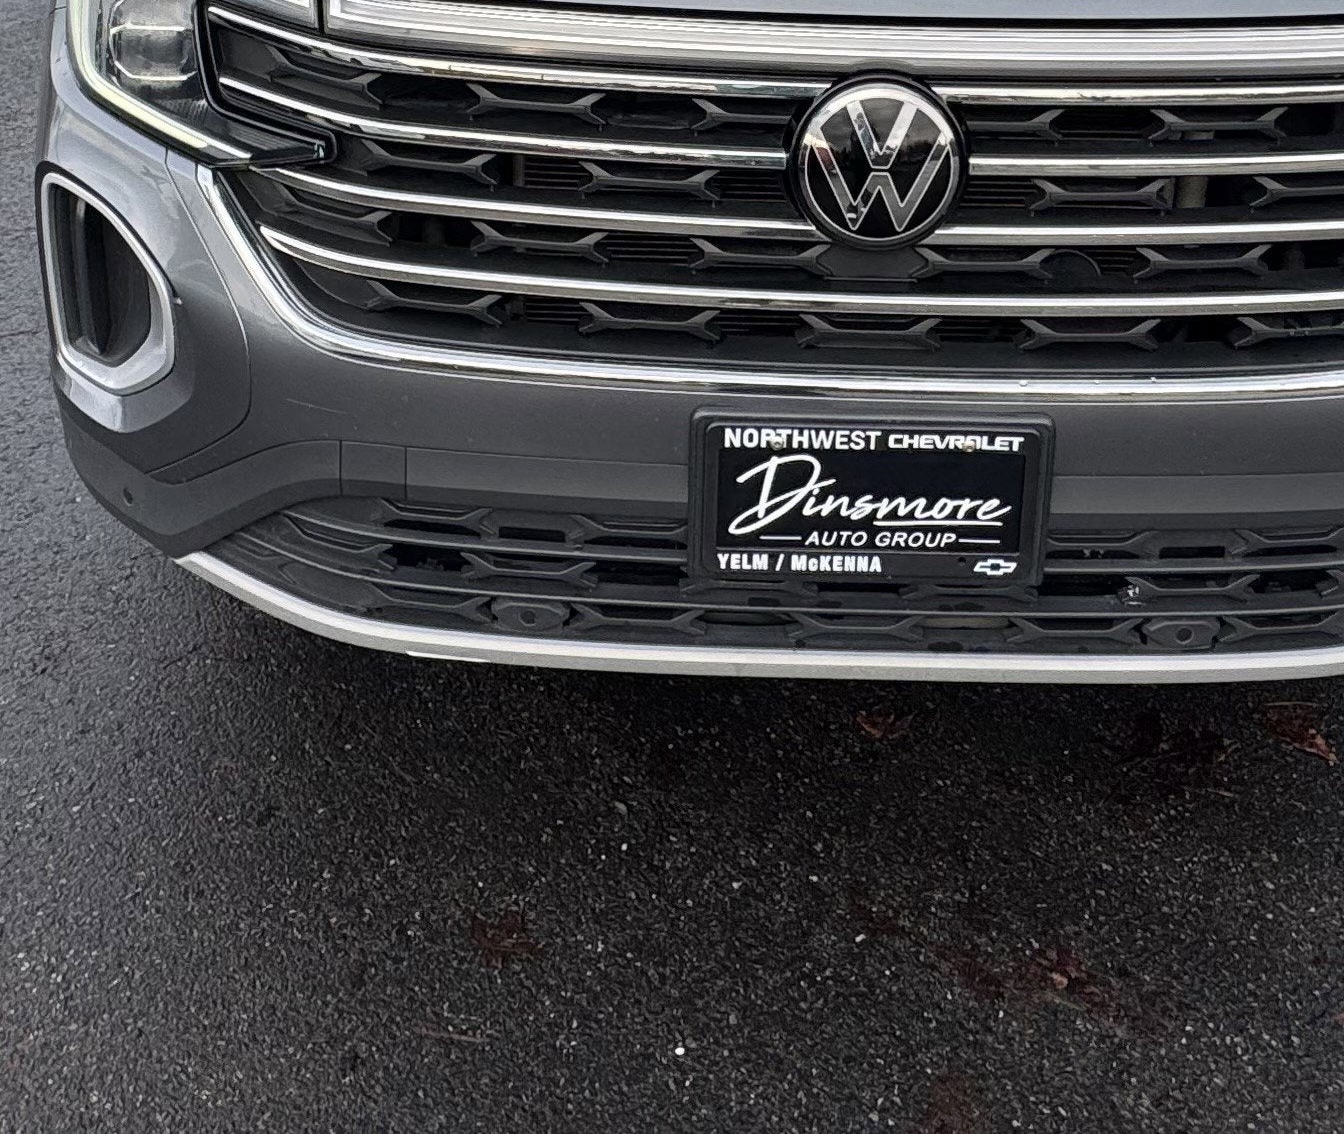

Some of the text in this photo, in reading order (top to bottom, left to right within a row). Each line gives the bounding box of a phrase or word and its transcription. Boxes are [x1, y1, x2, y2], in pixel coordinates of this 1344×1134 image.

[724, 427, 1025, 452] NORTHWEST CHEVROLET
[727, 454, 1013, 536] Dinsmore
[804, 531, 957, 548] AUTO GROUP
[716, 553, 882, 574] YELM / McKENNA
